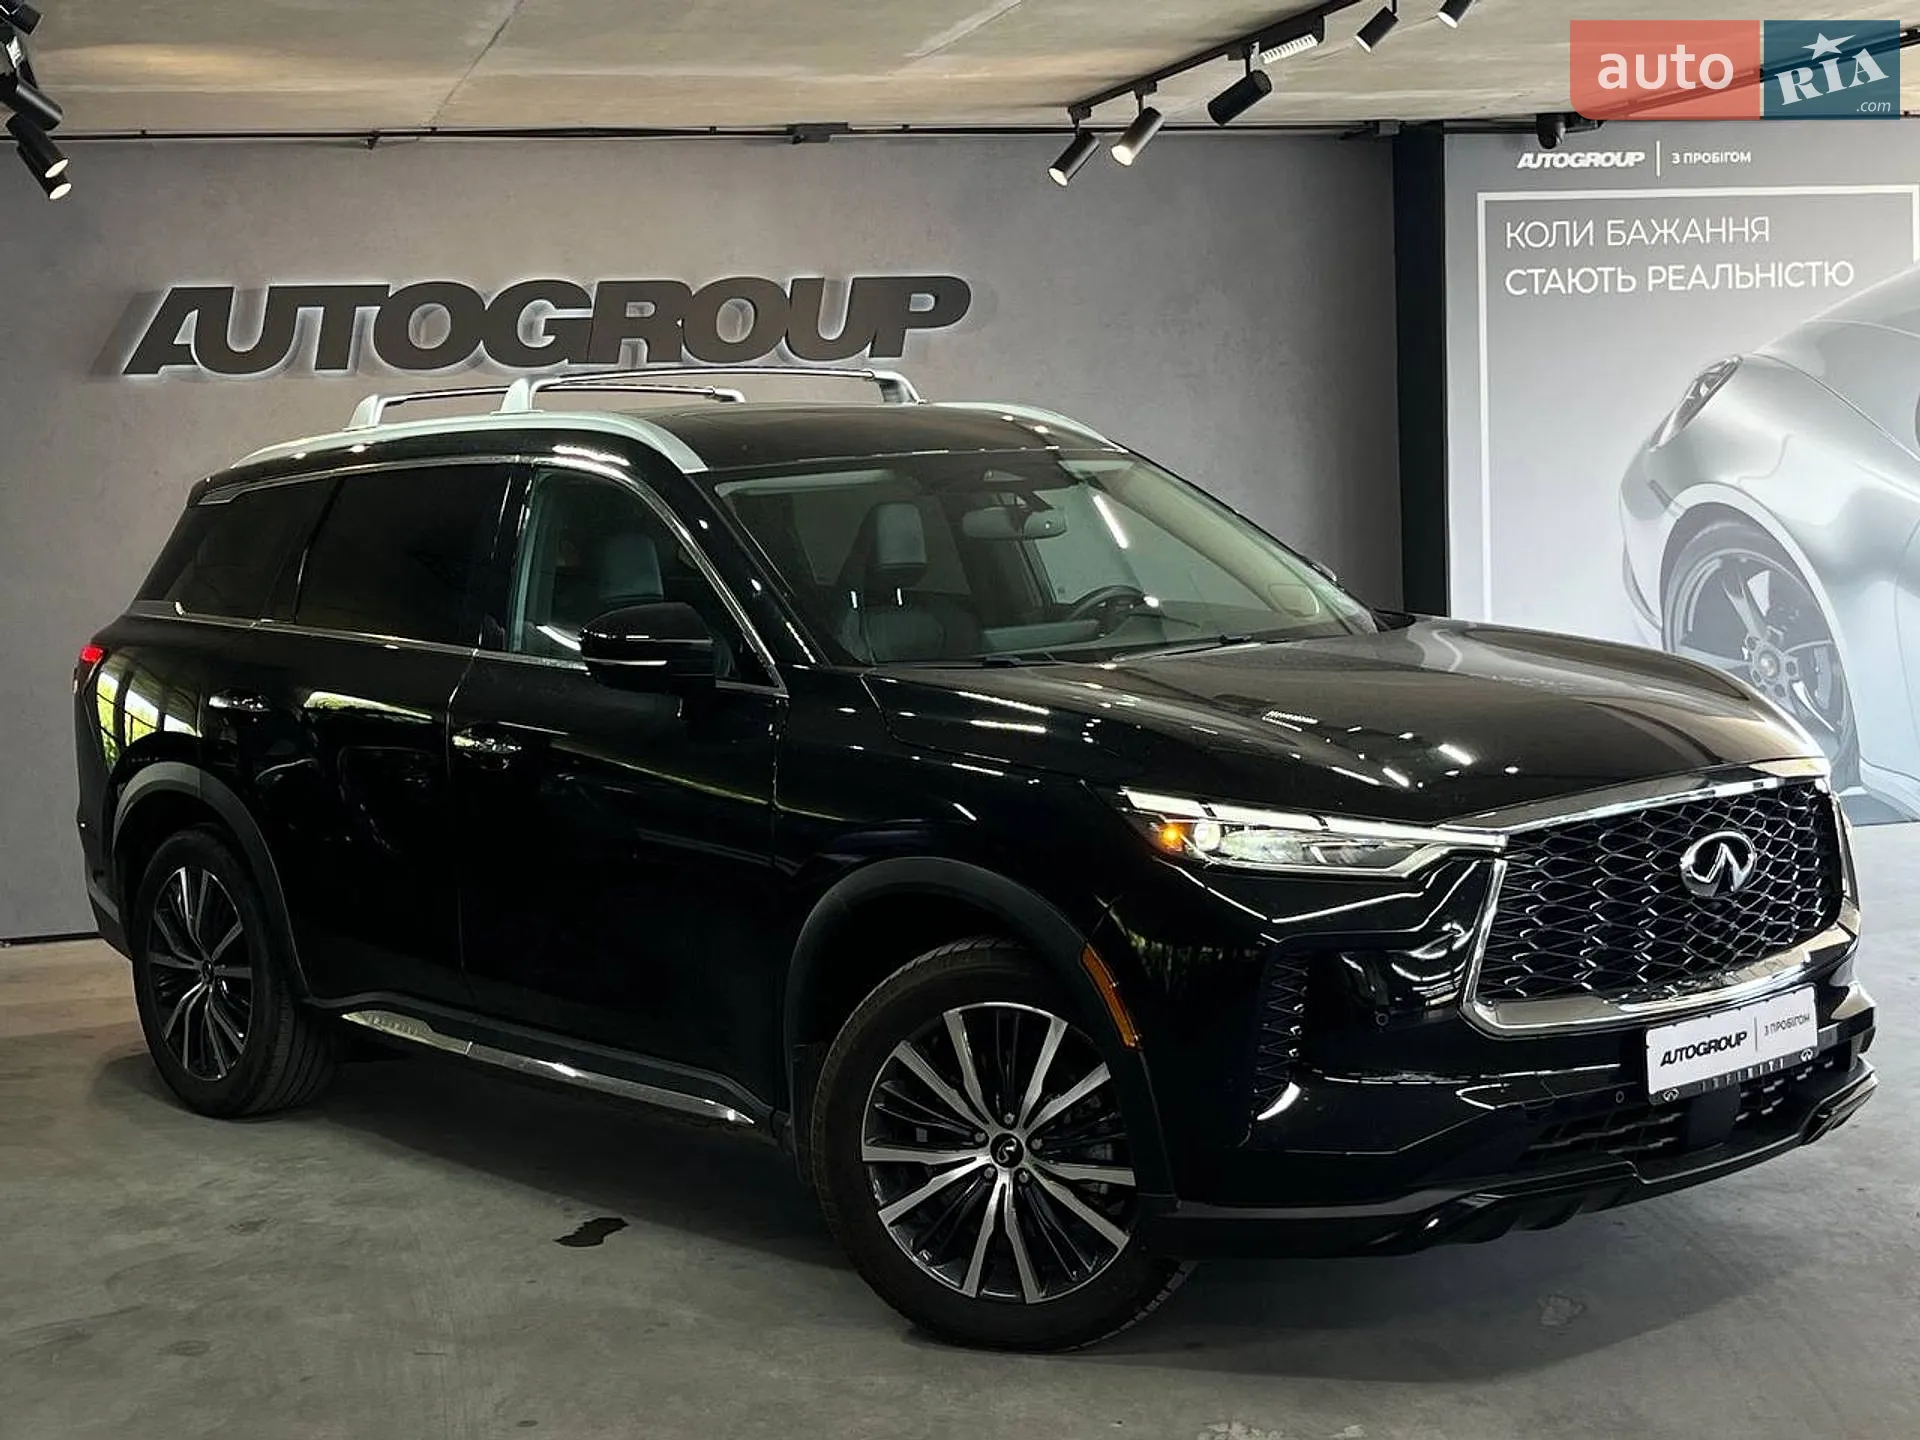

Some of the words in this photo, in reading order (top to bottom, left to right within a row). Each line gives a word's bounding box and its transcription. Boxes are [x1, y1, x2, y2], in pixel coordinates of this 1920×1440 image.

[1516, 151, 1646, 169] AUTOGROUP
[1683, 150, 1752, 165] ПРОБІГОМ
[1505, 219, 1594, 250] КОЛИ
[1606, 216, 1771, 247] БАЖАННЯ
[1504, 266, 1637, 296] СТАЮТЬ
[1647, 260, 1855, 292] РЕАЛЬНІСТЮ
[123, 275, 972, 375] AUTOGROUP
[1660, 1030, 1748, 1067] AUTOGROUP
